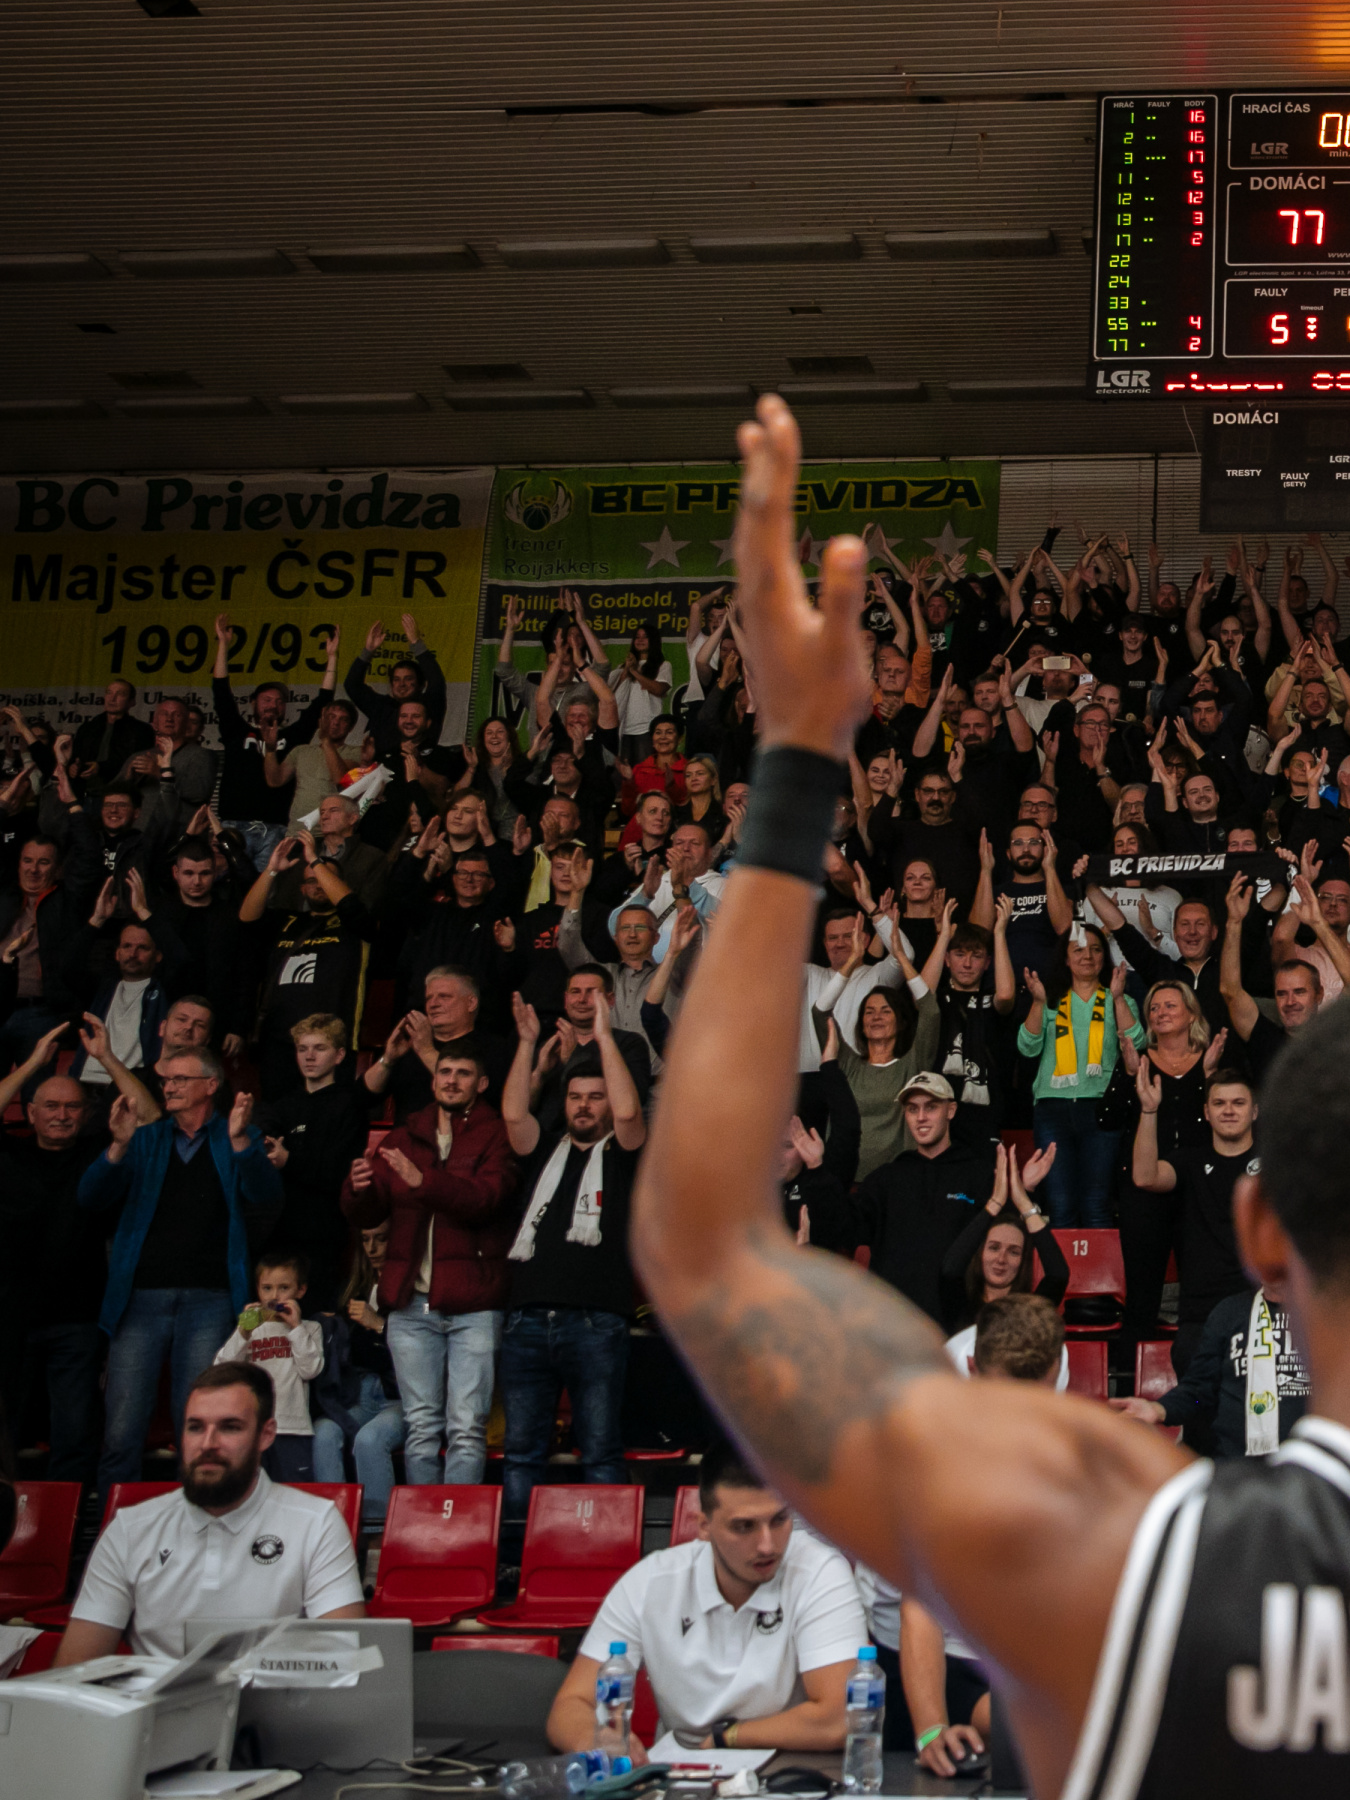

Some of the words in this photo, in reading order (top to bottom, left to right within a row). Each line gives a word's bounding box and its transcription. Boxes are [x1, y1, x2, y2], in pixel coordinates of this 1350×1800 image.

[1242, 102, 1282, 114] HRACÍ
[1285, 101, 1311, 114] ČAS
[1130, 112, 1135, 124] 1
[1188, 109, 1206, 123] 16
[1123, 132, 1134, 144] 2
[1188, 129, 1206, 143] 16
[1250, 142, 1289, 155] LGR
[1124, 152, 1133, 164] 3
[1188, 149, 1206, 164] 17
[1118, 172, 1133, 184] 11
[1192, 170, 1204, 184] 5
[1249, 173, 1327, 191] DOMÁCI
[1118, 193, 1132, 205] 12
[1187, 190, 1204, 205] 12
[1117, 213, 1131, 226] 13
[1192, 210, 1204, 225] 3
[1278, 209, 1325, 245] 77
[1116, 234, 1131, 246] 17
[1191, 230, 1203, 246] 2
[1109, 254, 1131, 268] 22
[1108, 275, 1130, 288] 24
[1253, 288, 1289, 297] FAULY
[1109, 296, 1129, 309] 33
[1107, 317, 1129, 330] 55
[1188, 315, 1202, 330] 4
[1270, 313, 1289, 344] 5
[1107, 338, 1128, 351] 77
[1188, 337, 1202, 351] 2
[1096, 370, 1151, 388] LGR
[1095, 387, 1151, 395] electronic
[1212, 410, 1280, 425] DOMÁCI
[1329, 455, 1350, 463] LGR
[1226, 469, 1262, 477] TRESTY
[1280, 472, 1310, 480] FAULY
[1283, 480, 1307, 488] (SETY)
[14, 478, 120, 533] BC
[141, 472, 463, 532] Prievidza
[590, 484, 667, 514] BC
[11, 551, 247, 614] Majster
[266, 538, 448, 600] ČSFR
[504, 557, 610, 580] Roijakkers
[588, 590, 678, 609] Godbold,
[1109, 857, 1134, 877] BC
[1135, 853, 1227, 875] PRIEVIDZA
[1072, 1239, 1089, 1257] 13
[442, 1499, 454, 1519] 9
